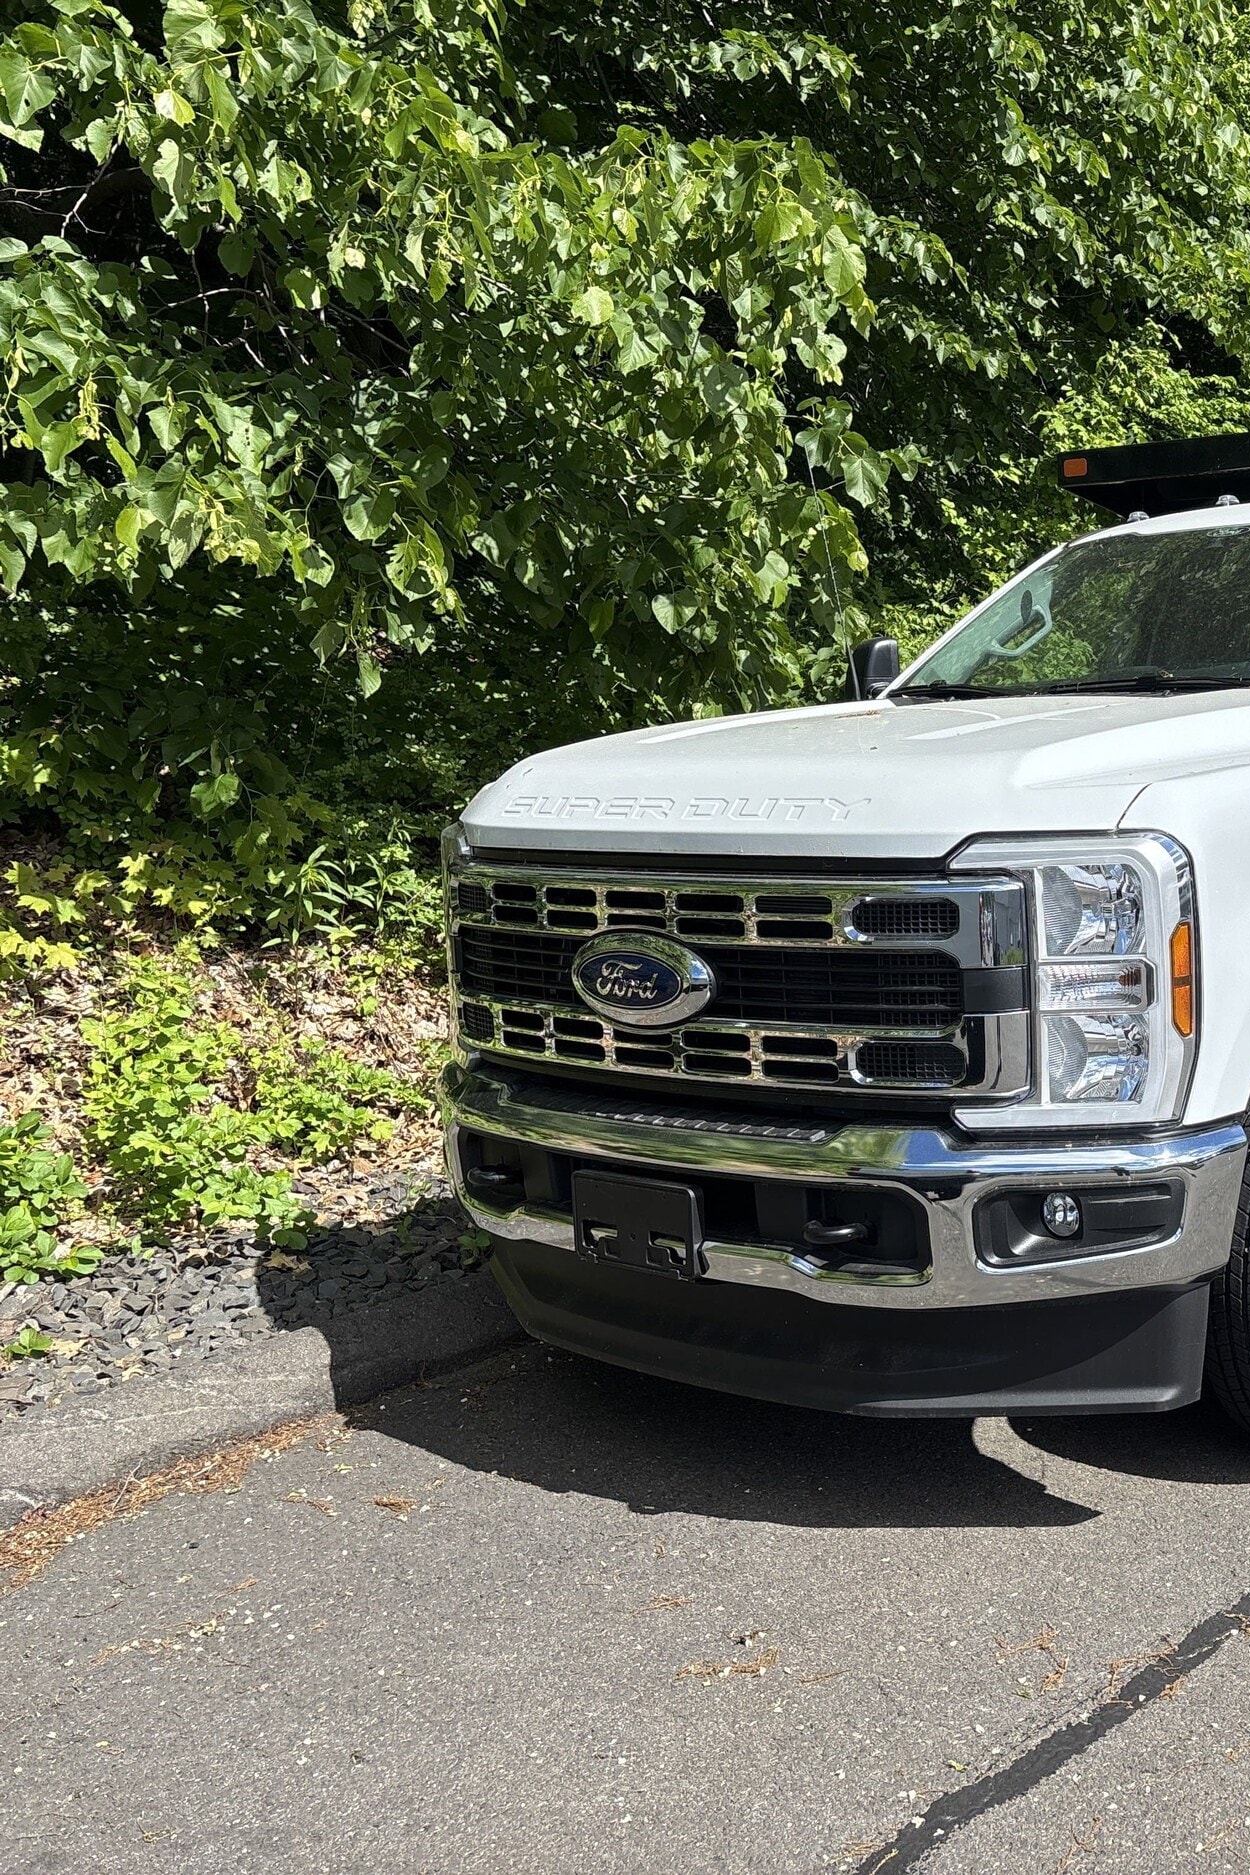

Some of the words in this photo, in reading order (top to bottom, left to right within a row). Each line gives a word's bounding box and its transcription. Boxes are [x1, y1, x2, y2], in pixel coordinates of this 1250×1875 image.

[501, 796, 676, 820] SUPER
[681, 797, 873, 822] DUTY
[596, 959, 659, 999] Ford
